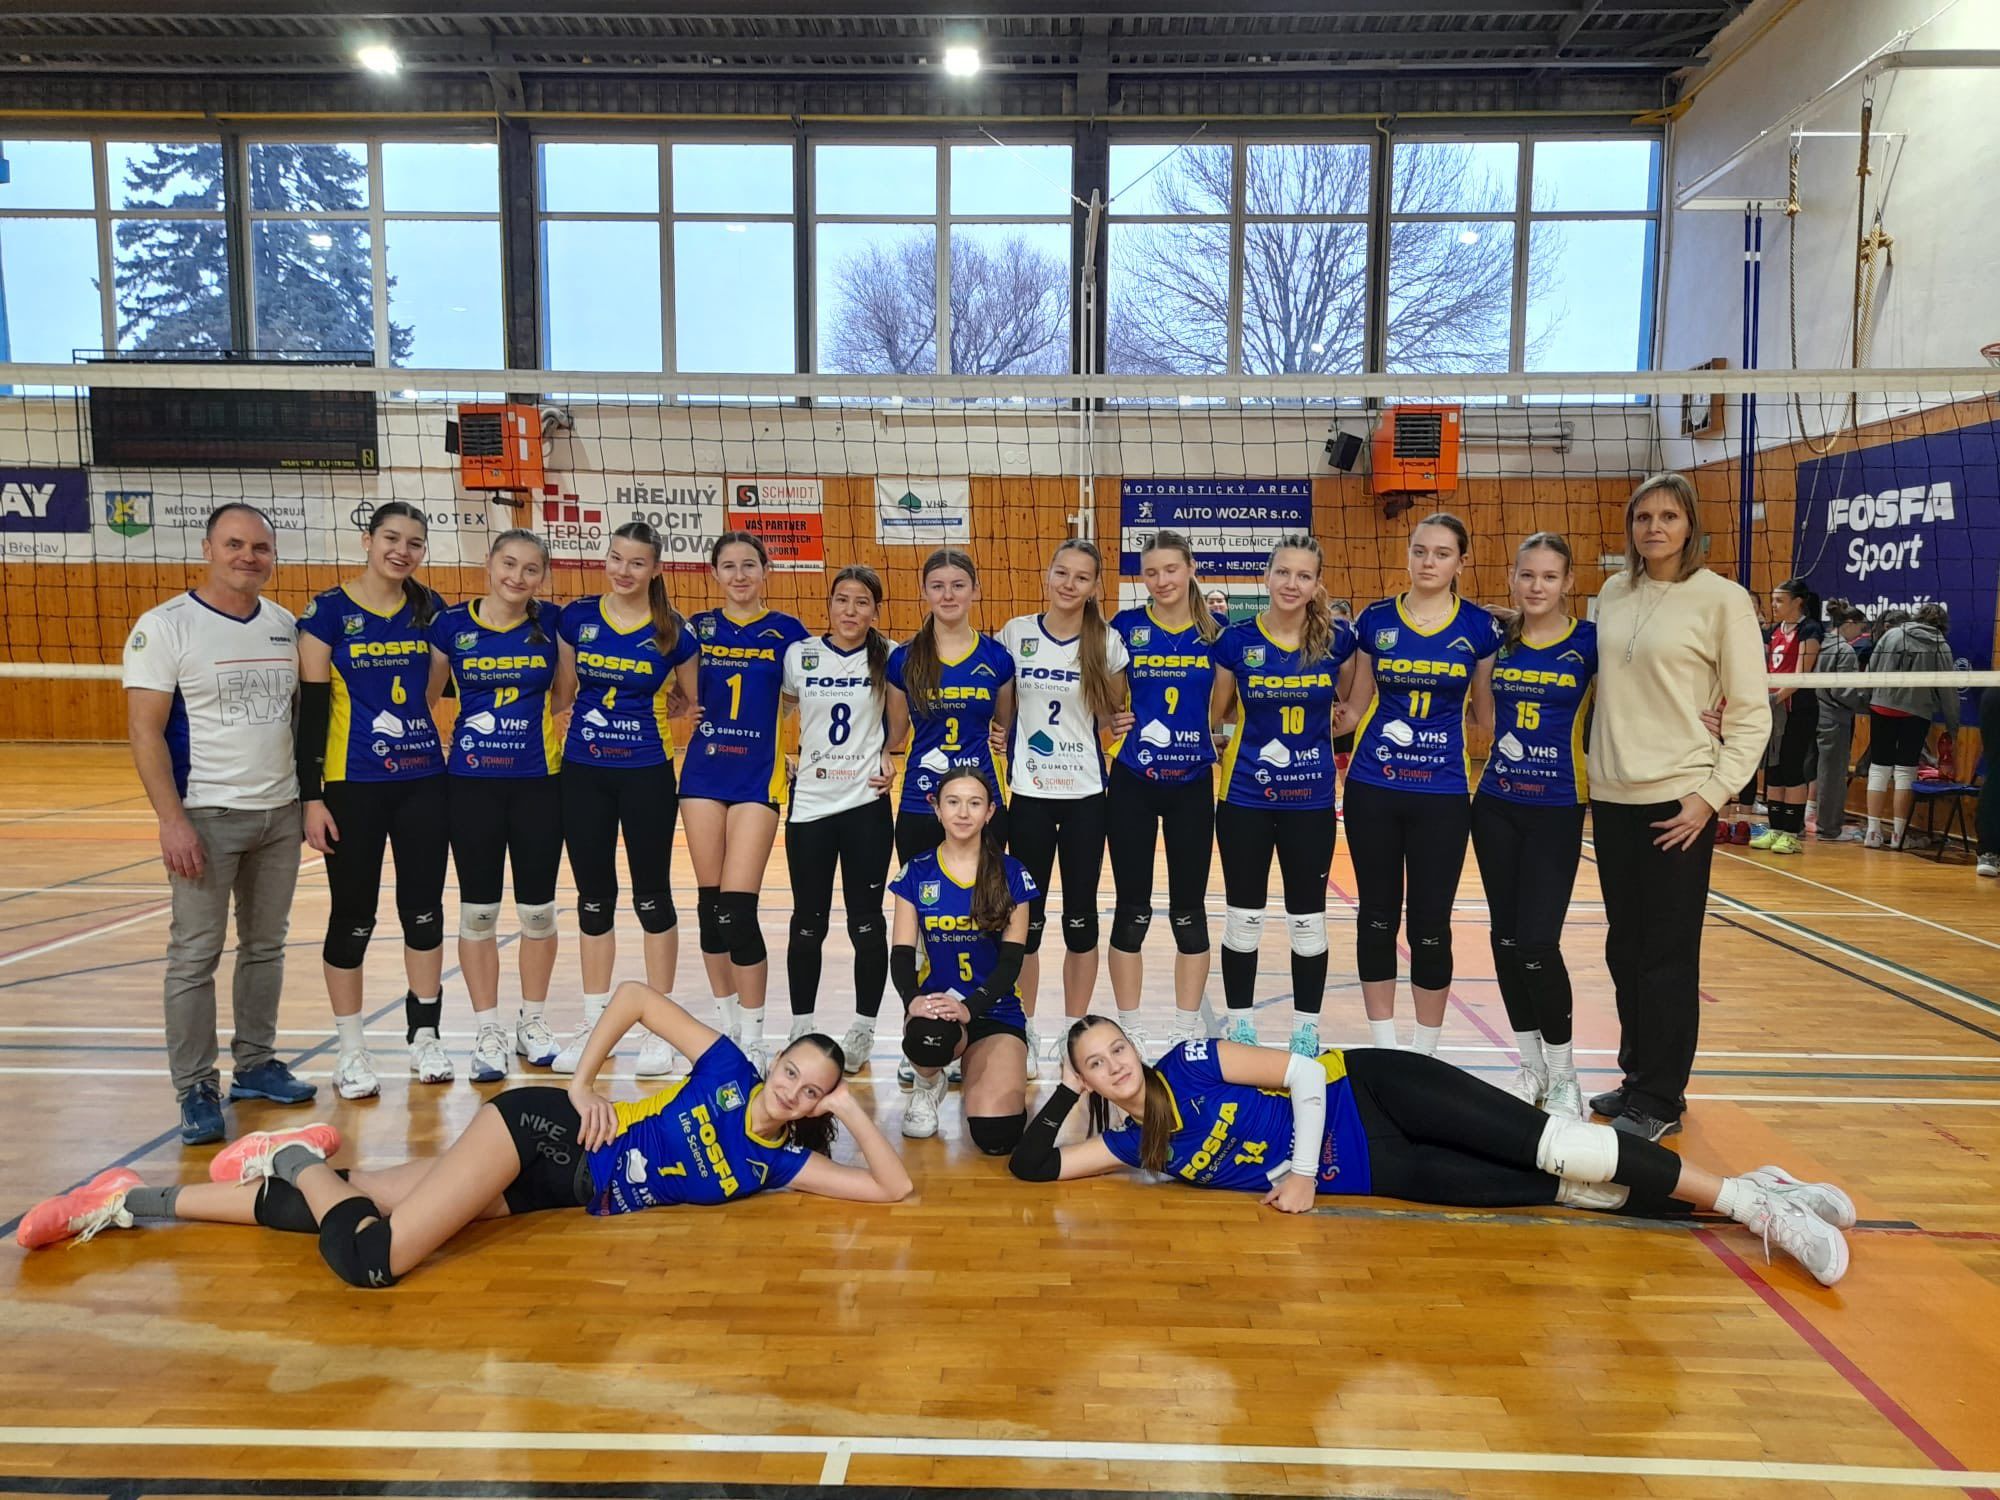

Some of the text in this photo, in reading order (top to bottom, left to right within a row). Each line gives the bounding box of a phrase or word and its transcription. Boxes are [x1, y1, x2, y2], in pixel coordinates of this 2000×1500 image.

[616, 482, 717, 505] HŘEJIVÝ
[761, 486, 815, 499] SCHMIDT
[925, 499, 949, 509] VHS
[1827, 481, 1955, 534] FOSFA
[631, 511, 703, 529] POCIT
[1173, 507, 1302, 520] AUTO WOZAR s.r.o.
[766, 519, 807, 531] PARTNER
[543, 525, 601, 539] TEPLO
[9, 542, 59, 553] Břeclav
[1197, 537, 1226, 547] AUTO
[1845, 533, 1923, 581] Sport
[349, 640, 430, 658] FOSFA
[700, 643, 776, 662] FOSFA
[351, 657, 410, 669] Life Science
[462, 655, 547, 670] FOSFA
[576, 651, 653, 675] FOSFA
[710, 658, 749, 668] Science
[1133, 655, 1211, 669] FOSFA
[1771, 645, 1784, 670] 6
[588, 668, 625, 681] Science
[1021, 667, 1081, 682] FOSF
[1133, 669, 1187, 678] Life Science
[1377, 658, 1467, 678] FOSFA
[463, 671, 522, 681] Life Science
[1248, 674, 1333, 689] FOSFA
[1376, 674, 1438, 685] Life Science
[1492, 668, 1577, 688] FOSFA
[216, 668, 297, 700] FAIR
[390, 676, 407, 705] 6
[1019, 681, 1070, 693] Life Science
[1504, 683, 1546, 694] Science
[602, 686, 618, 710] 4
[725, 672, 743, 720] 1
[804, 689, 854, 698] Life Science
[1247, 690, 1309, 699] Life Science
[1164, 686, 1180, 715] 9
[1408, 690, 1431, 719] 11
[1048, 700, 1062, 725] 2
[1516, 701, 1541, 730] 15
[500, 718, 530, 731] VHS
[612, 720, 641, 731] VHS
[828, 703, 851, 746] 8
[1279, 706, 1305, 735] 10
[598, 731, 643, 742] GUMOTEX
[717, 727, 761, 739] GUMOTEX
[945, 717, 959, 744] 3
[1175, 731, 1200, 742] VHS
[1418, 731, 1448, 744] VHS
[478, 740, 527, 750] GUMOTEX
[1058, 742, 1084, 752] VHS
[1528, 745, 1558, 758] VHS
[825, 753, 866, 761] GUMOTEX
[1157, 754, 1201, 762] GUMOTEX
[1295, 748, 1320, 761] VHS
[1396, 752, 1446, 764] GUMOTEX
[953, 757, 980, 767] VHS
[1041, 763, 1084, 771] GUMOTEX
[1045, 777, 1075, 786] SCHMIDT
[1276, 772, 1322, 782] GUMOTEX
[927, 933, 978, 942] Life Science
[957, 952, 974, 982] 5
[520, 1112, 567, 1142] NIKE
[678, 1112, 709, 1178] Life Science
[1179, 1102, 1238, 1180] FOSFA
[690, 1104, 739, 1198] FOSFA
[1208, 1137, 1237, 1172] Science
[1234, 1141, 1268, 1166] 14
[657, 1161, 687, 1177] 7
